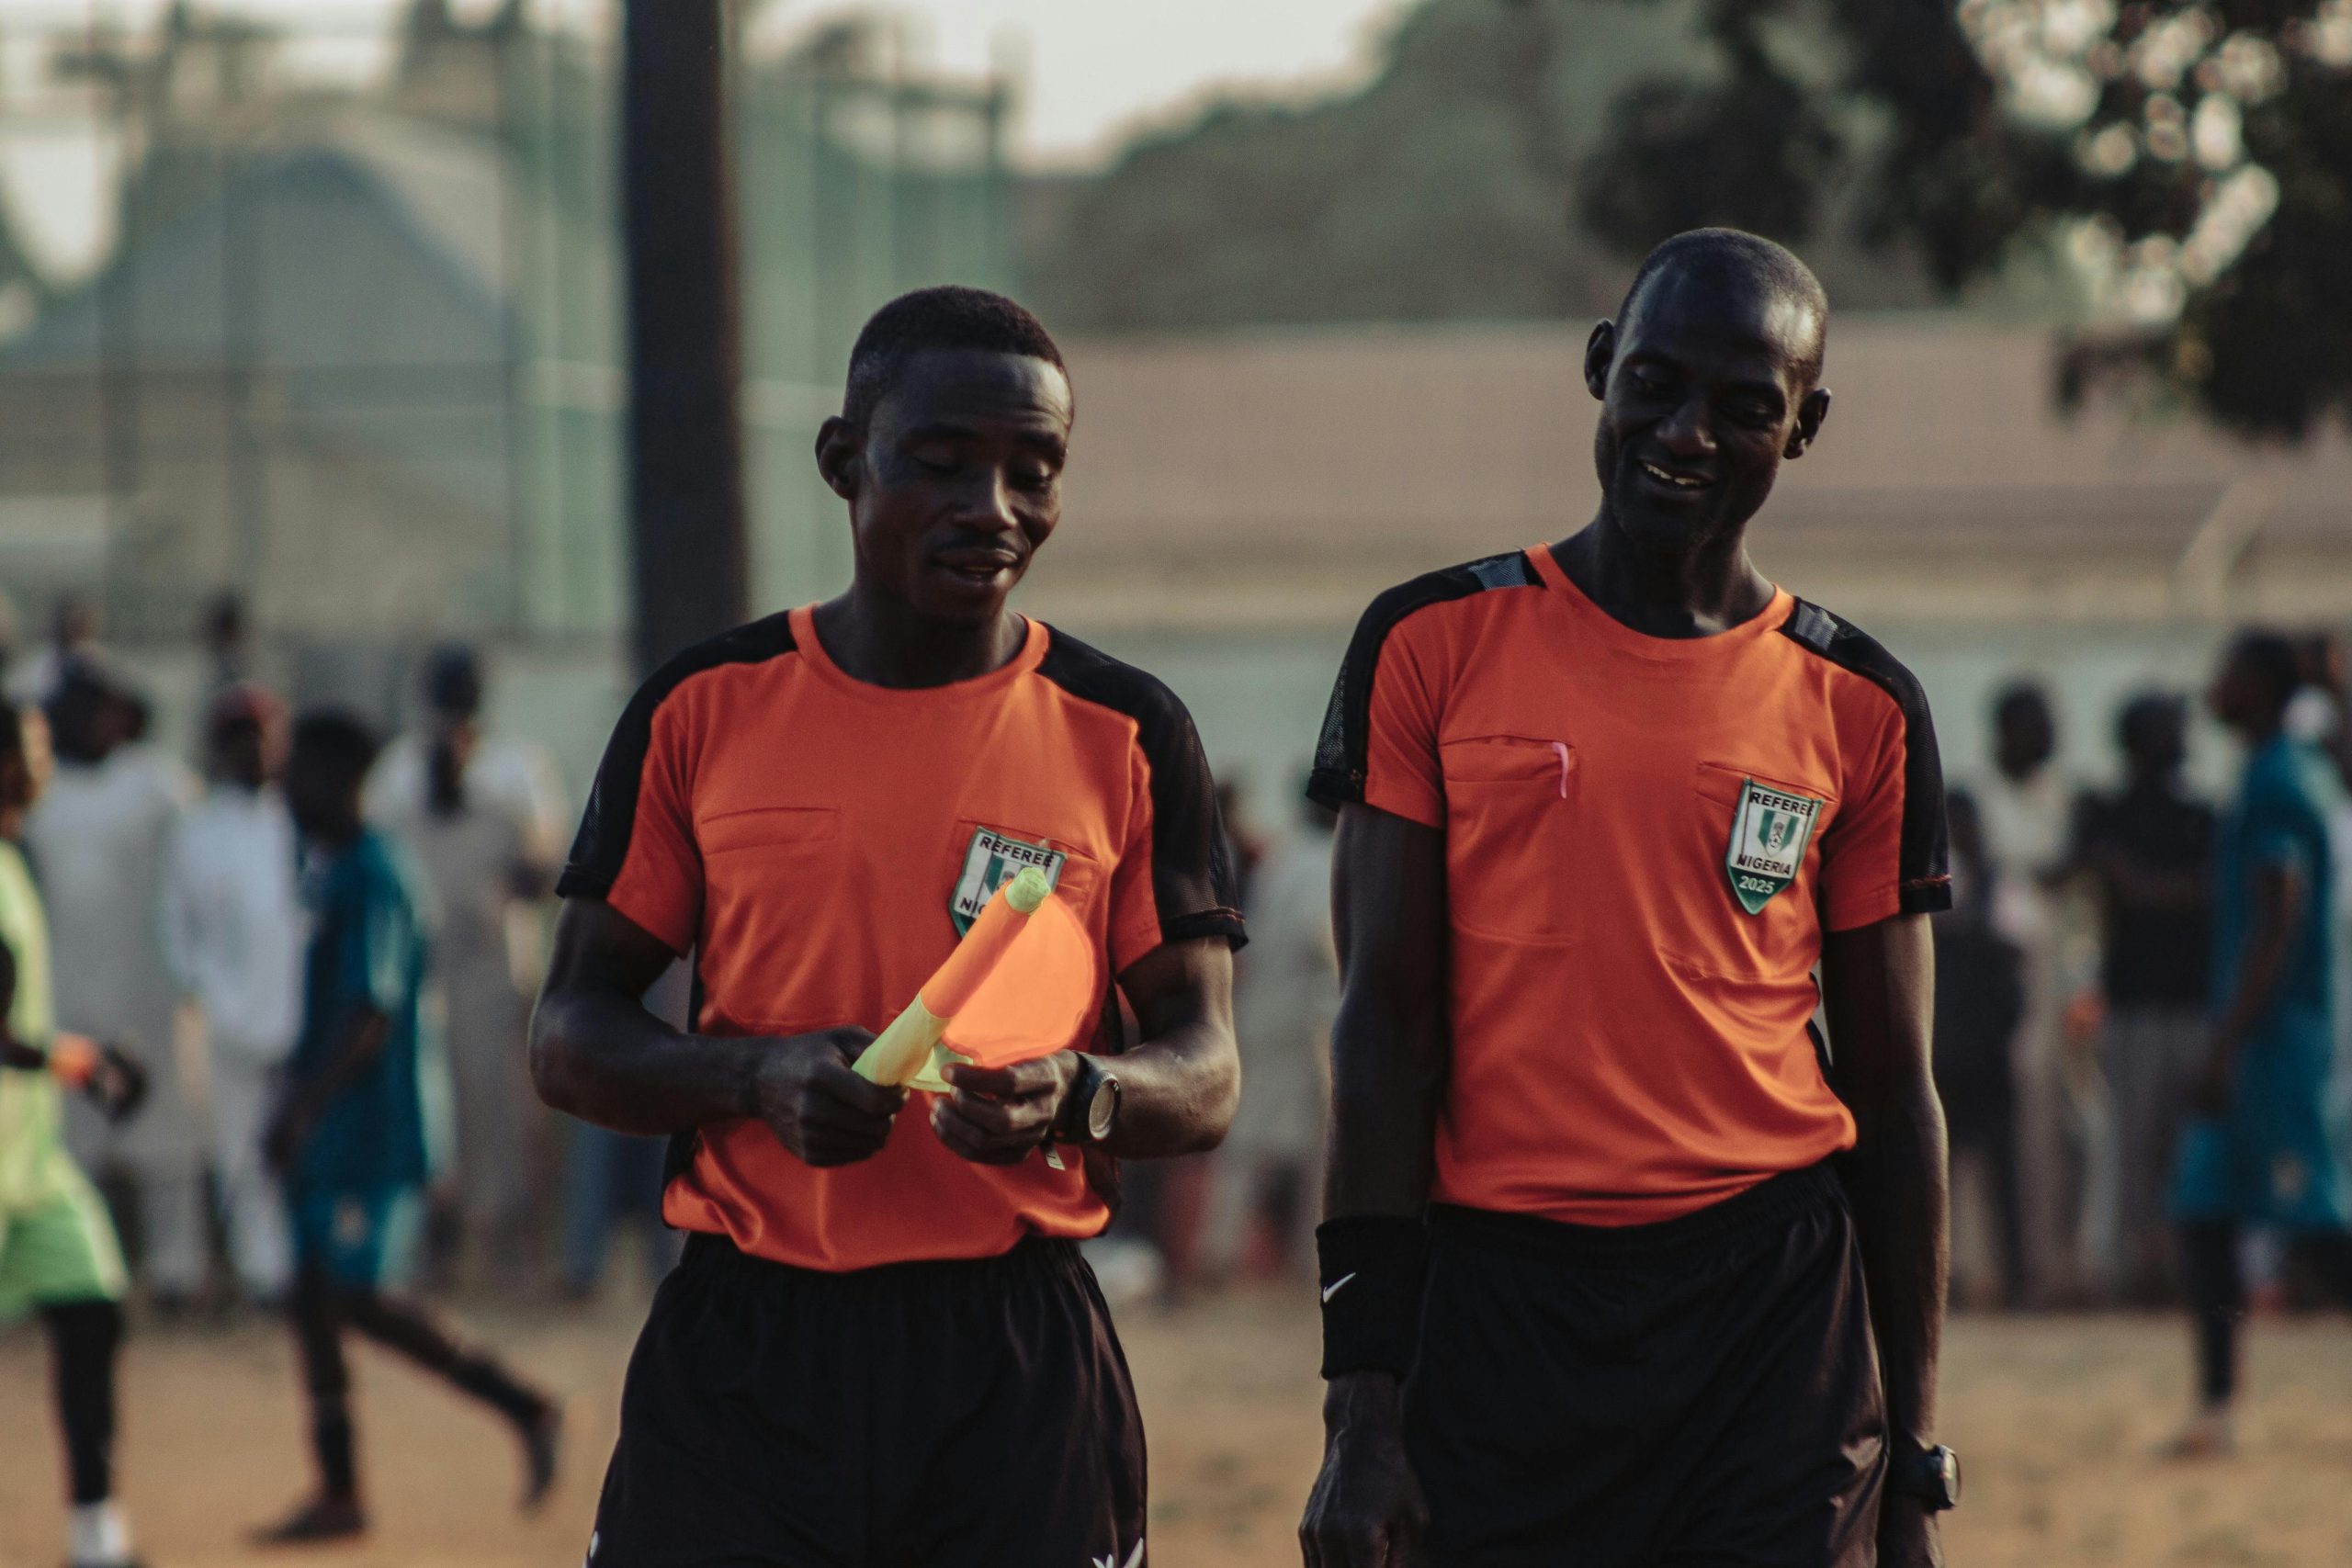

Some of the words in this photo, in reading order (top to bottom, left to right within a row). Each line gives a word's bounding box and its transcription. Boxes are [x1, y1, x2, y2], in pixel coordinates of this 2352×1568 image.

[1749, 791, 1814, 816] REFEREE
[979, 836, 1054, 867] REFEREE
[1736, 853, 1792, 875] NIGERIA
[1738, 875, 1775, 894] 2025
